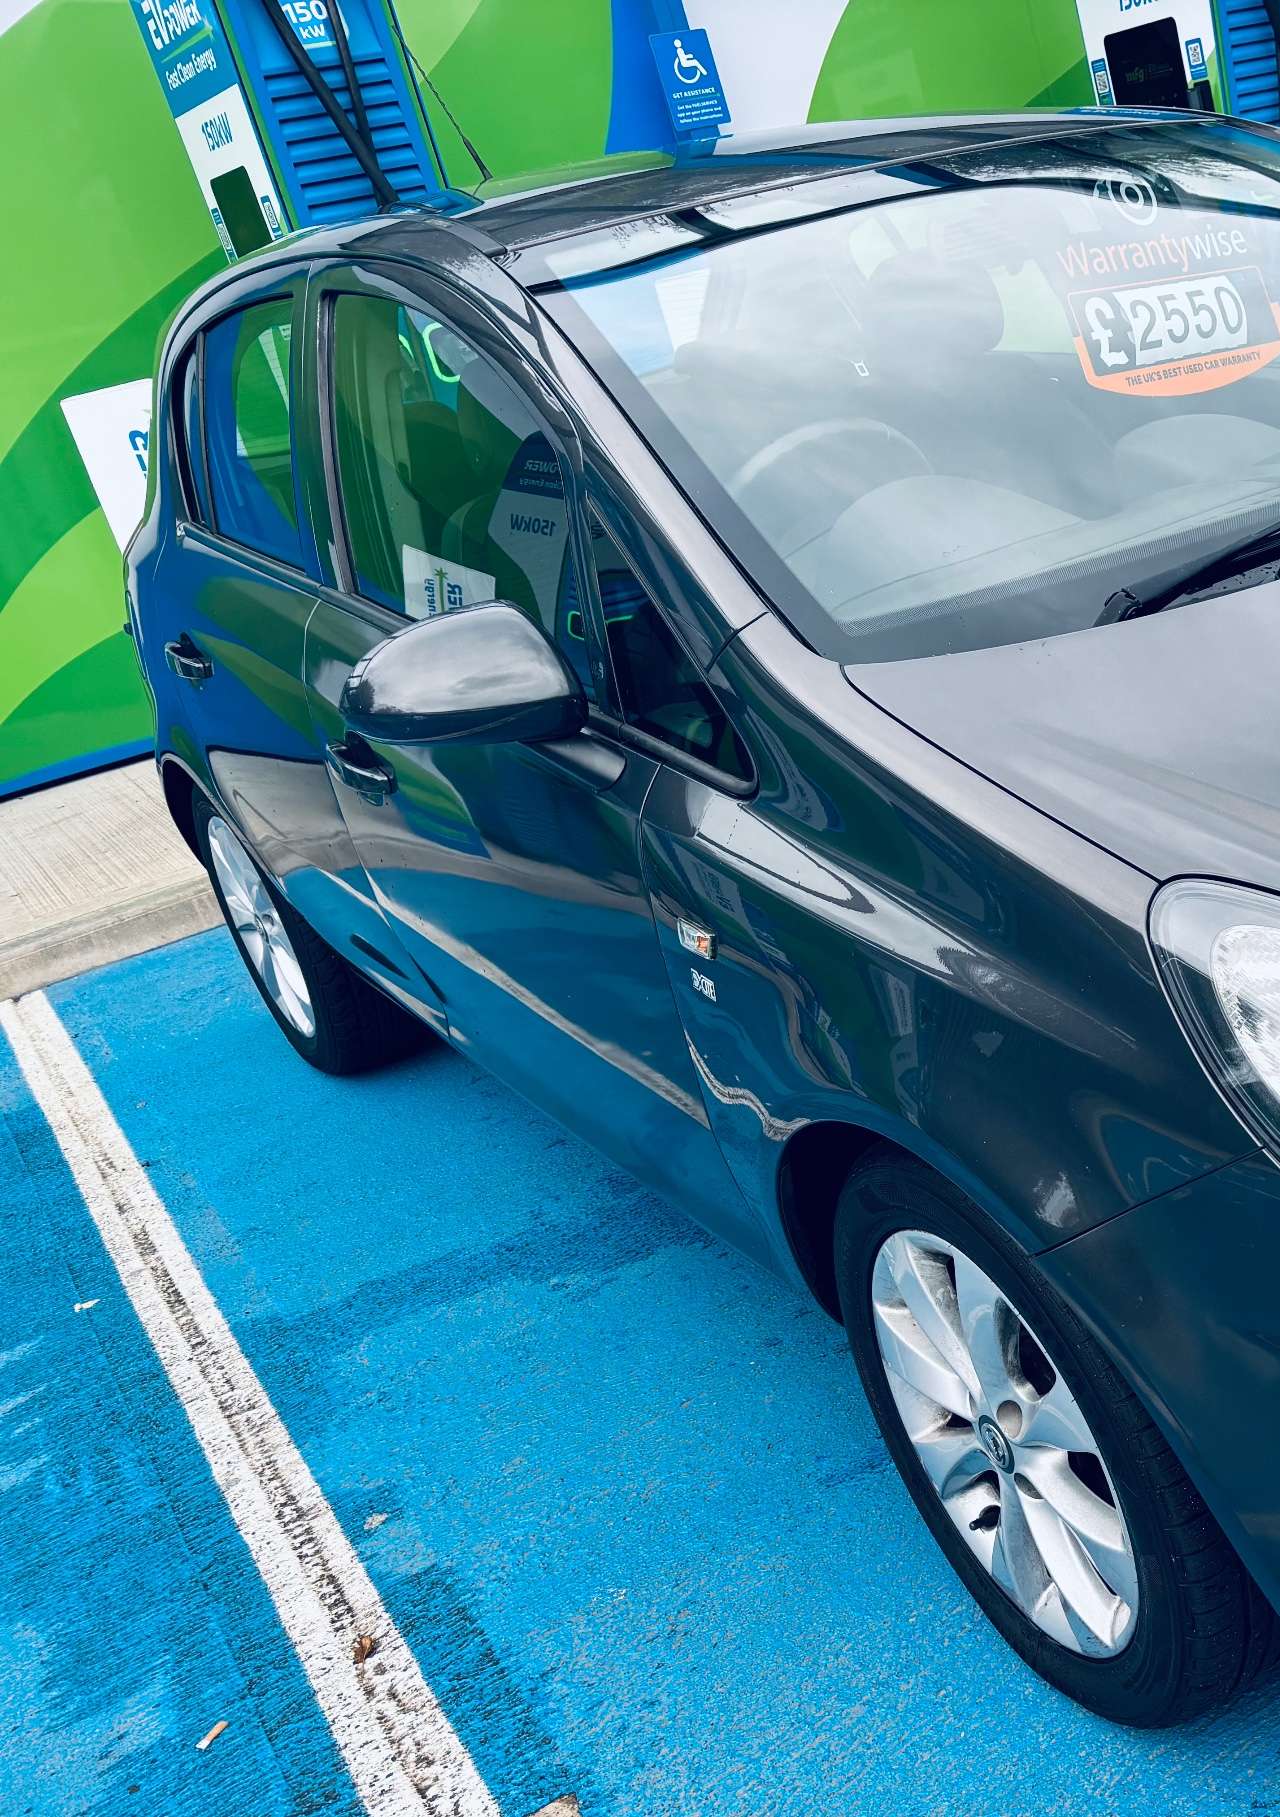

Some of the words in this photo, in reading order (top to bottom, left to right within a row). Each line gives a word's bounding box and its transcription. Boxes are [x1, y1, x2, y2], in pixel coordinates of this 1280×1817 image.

[281, 0, 328, 23] 150
[299, 24, 325, 39] kW
[165, 68, 182, 91] Fast
[177, 62, 196, 83] Clean
[192, 48, 217, 74] Energy
[201, 112, 233, 151] 150kW
[1056, 223, 1249, 279] Warrantywise
[1125, 376, 1143, 388] THE
[1143, 370, 1163, 384] UK'S
[1163, 366, 1182, 379] BEST
[1183, 363, 1204, 375] USED
[1204, 359, 1219, 369] CAR
[1220, 351, 1262, 367] WARRANTY
